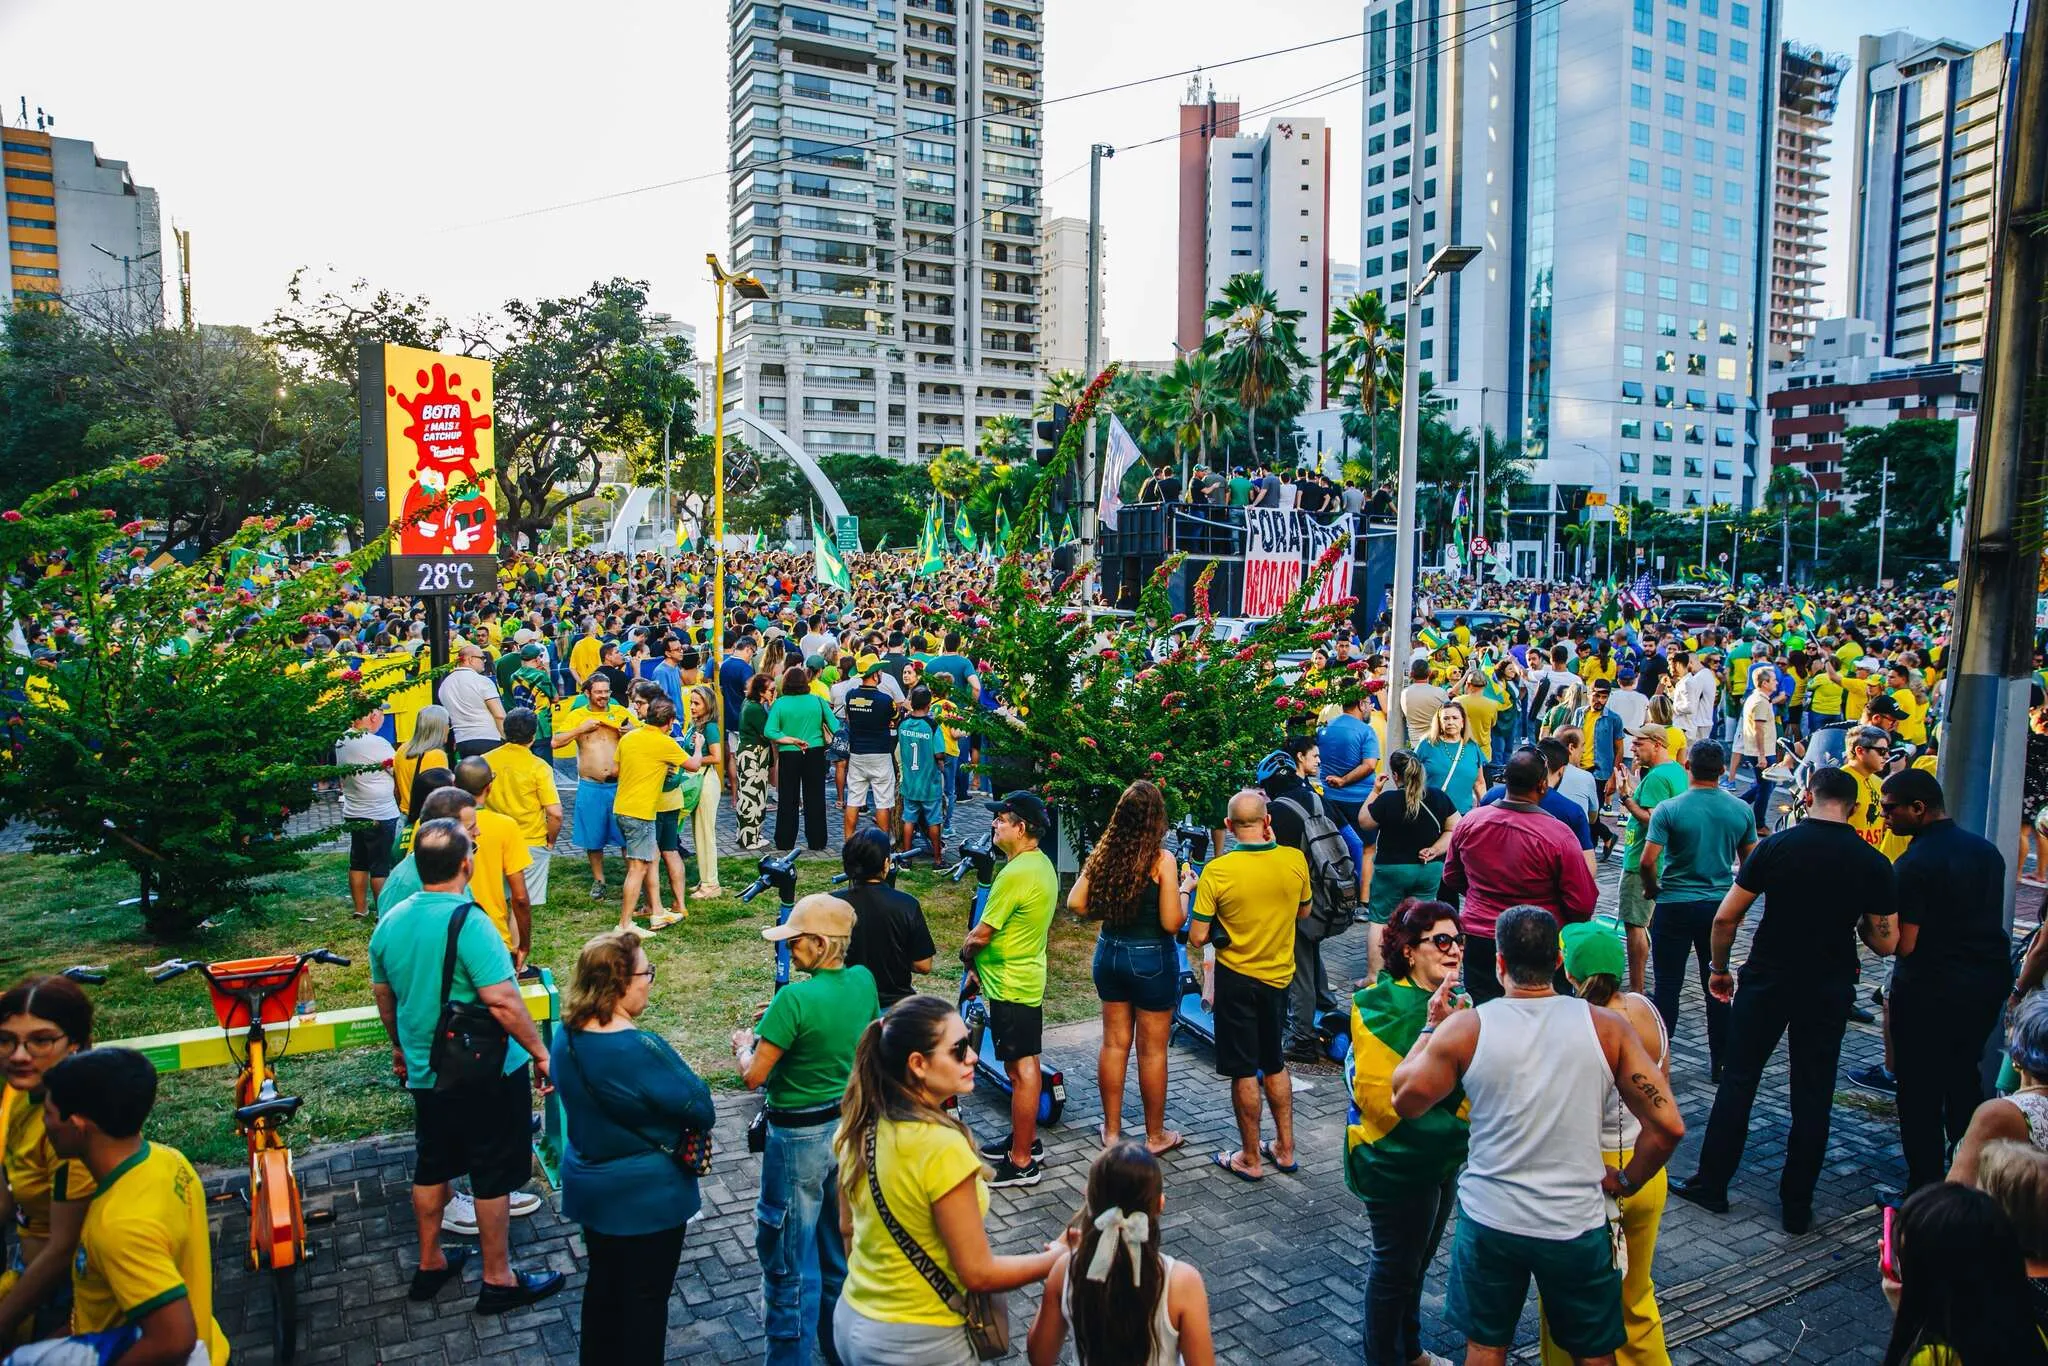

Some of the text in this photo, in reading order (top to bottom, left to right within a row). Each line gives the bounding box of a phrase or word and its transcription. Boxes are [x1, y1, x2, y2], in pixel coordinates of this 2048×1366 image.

[422, 403, 461, 420] BOTA
[430, 421, 455, 431] MAIS
[423, 431, 462, 441] CATCHUP
[1246, 508, 1301, 553] FORA
[910, 742, 919, 771] 1
[777, 960, 785, 977] JET
[1631, 1072, 1668, 1109] CMC
